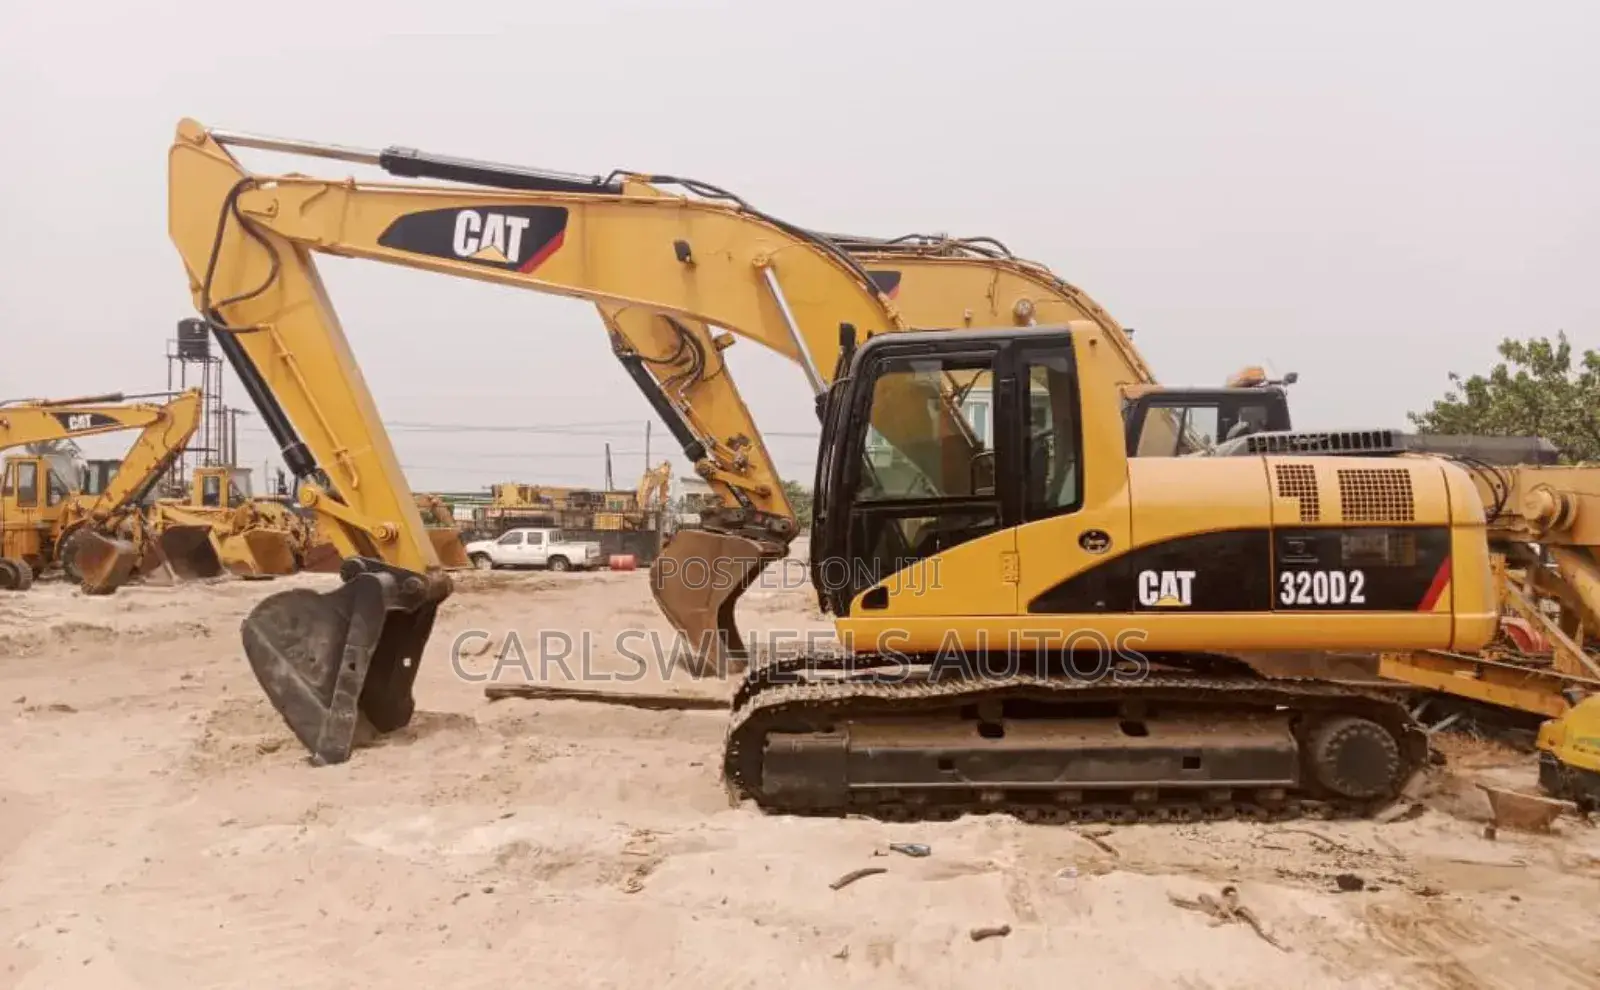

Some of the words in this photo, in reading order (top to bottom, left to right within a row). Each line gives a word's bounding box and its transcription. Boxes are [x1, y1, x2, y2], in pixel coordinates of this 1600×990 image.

[453, 209, 530, 263] CAT
[68, 414, 91, 430] CAT
[1138, 570, 1196, 606] CAT
[1280, 570, 1366, 605] 320D2
